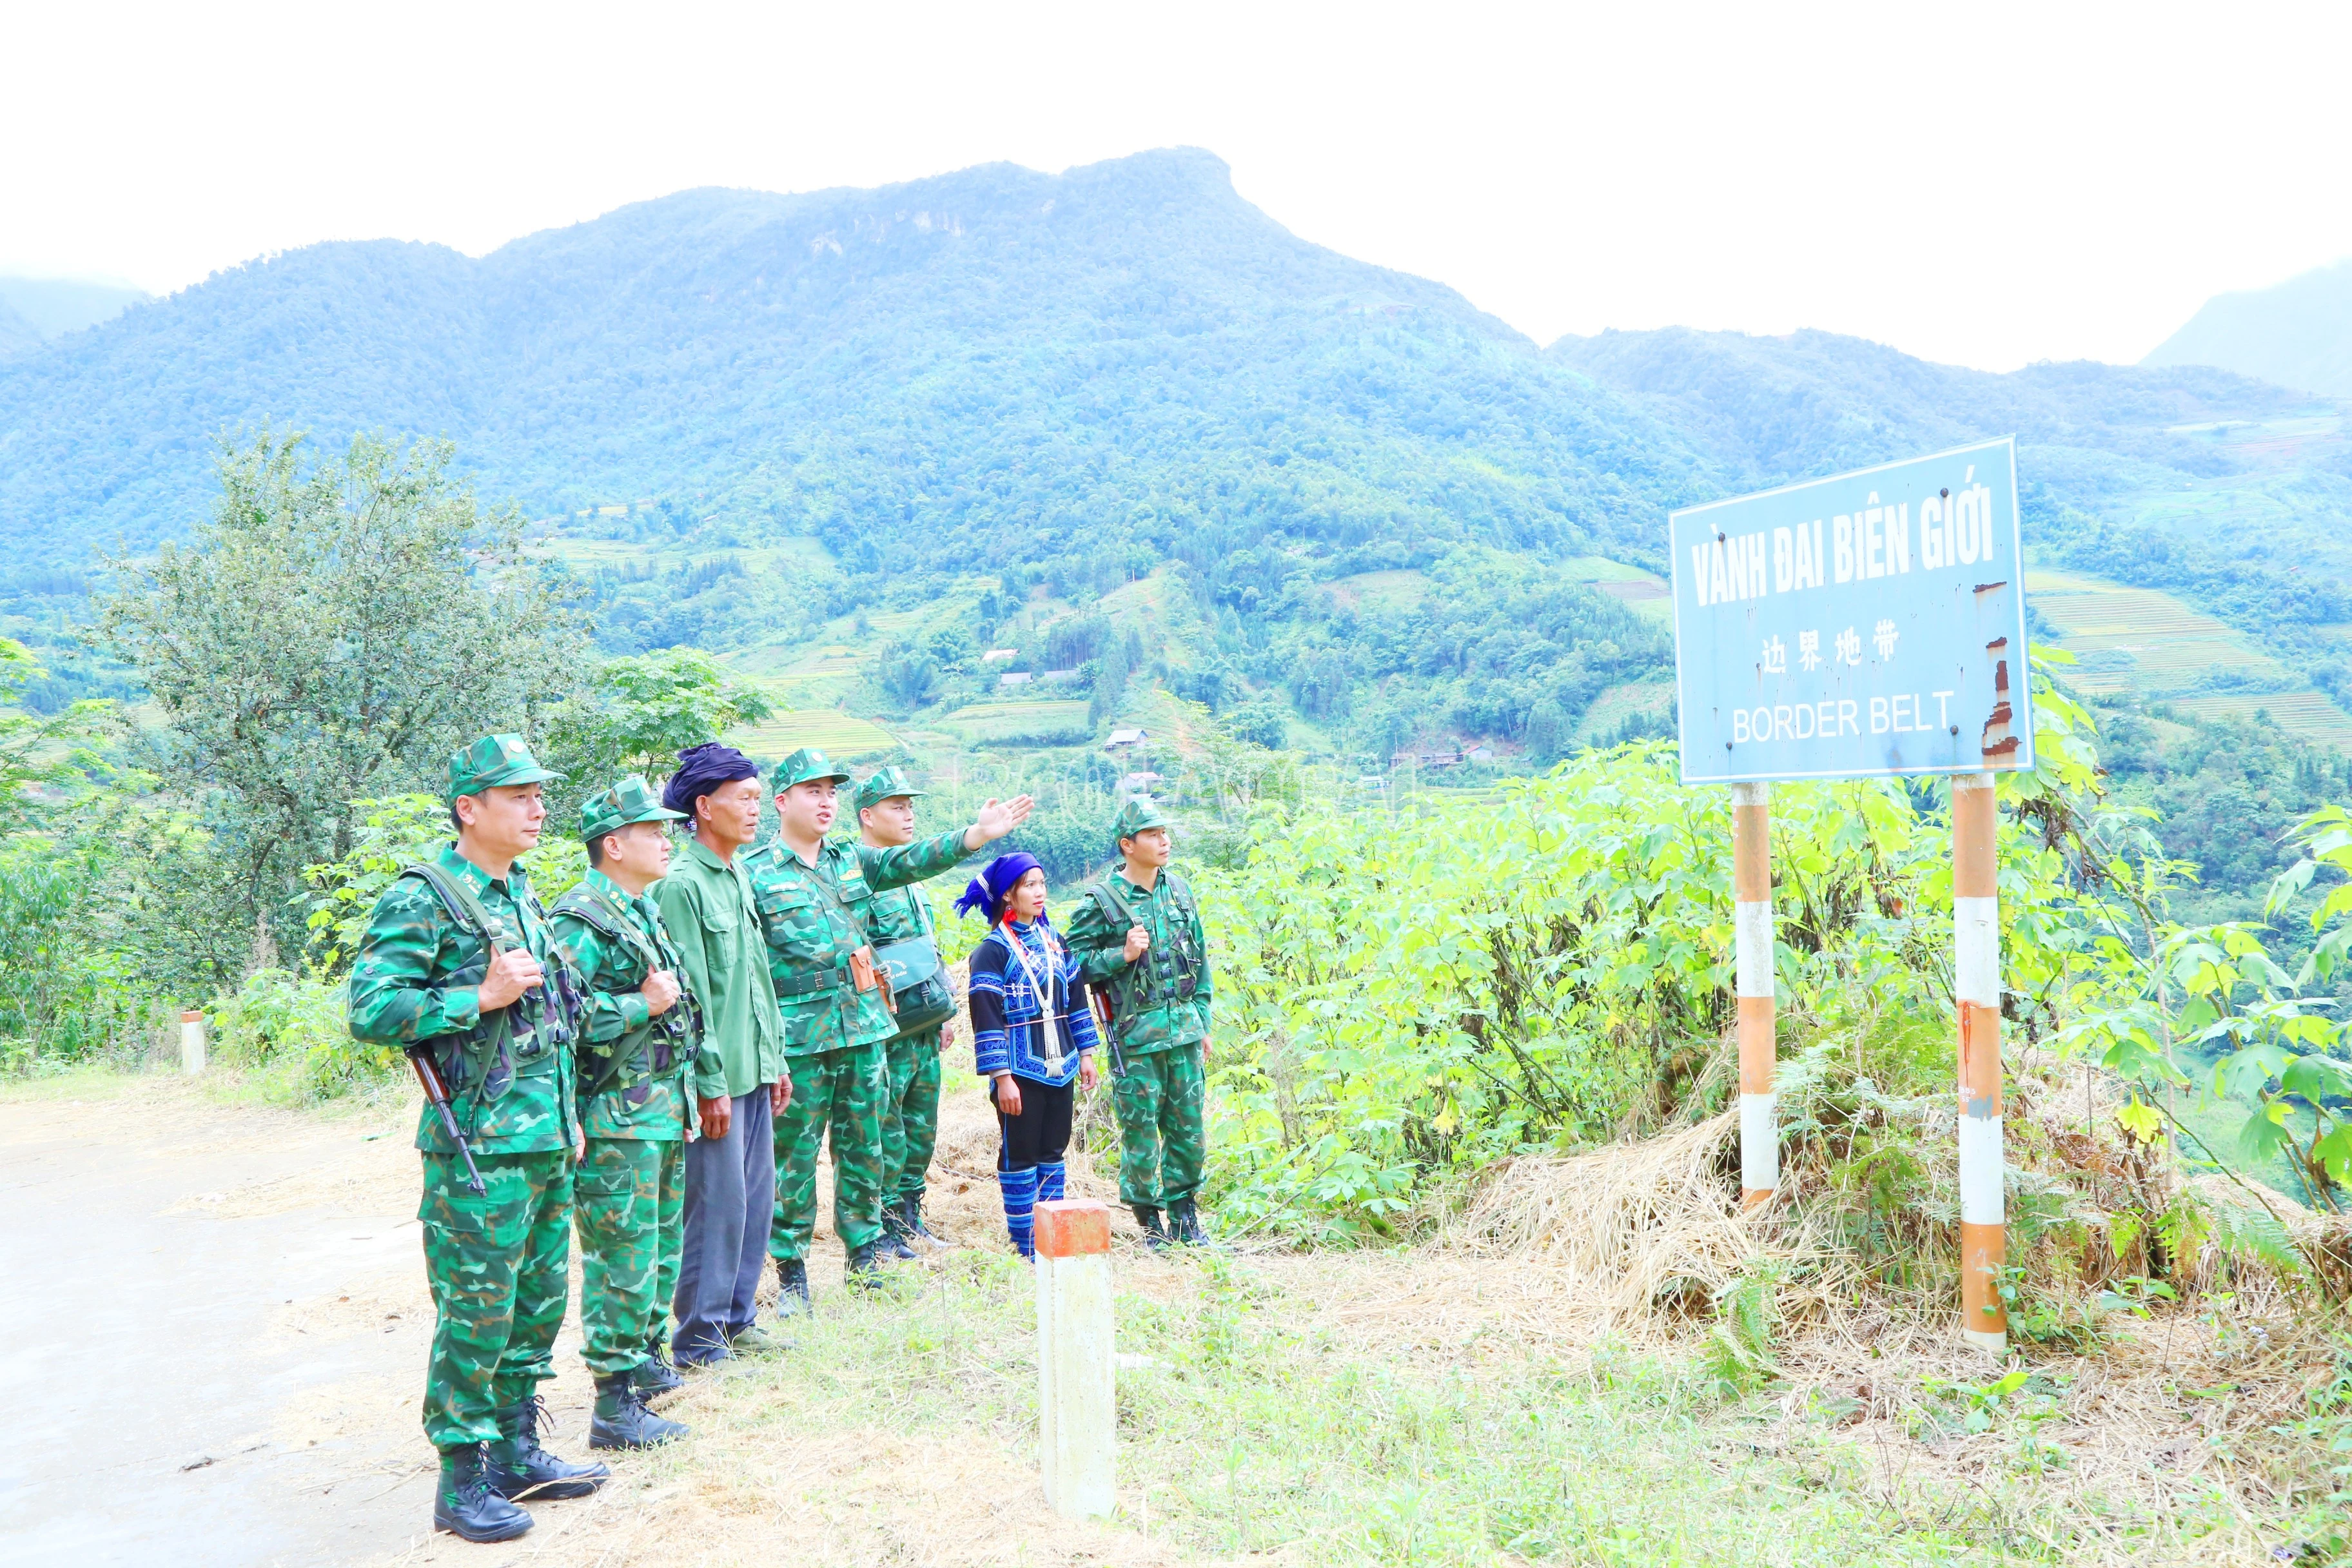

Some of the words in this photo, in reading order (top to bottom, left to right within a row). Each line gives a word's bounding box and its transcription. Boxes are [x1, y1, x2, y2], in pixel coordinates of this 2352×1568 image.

[1692, 523, 1767, 607] VÀNH
[1773, 520, 1825, 594] ĐAI
[1833, 491, 1910, 583] BIÊN
[1920, 465, 1994, 571] GIỚI
[1761, 619, 1900, 674] 边界地带
[1733, 699, 1860, 743] BORDER
[1870, 690, 1954, 734] BELT
